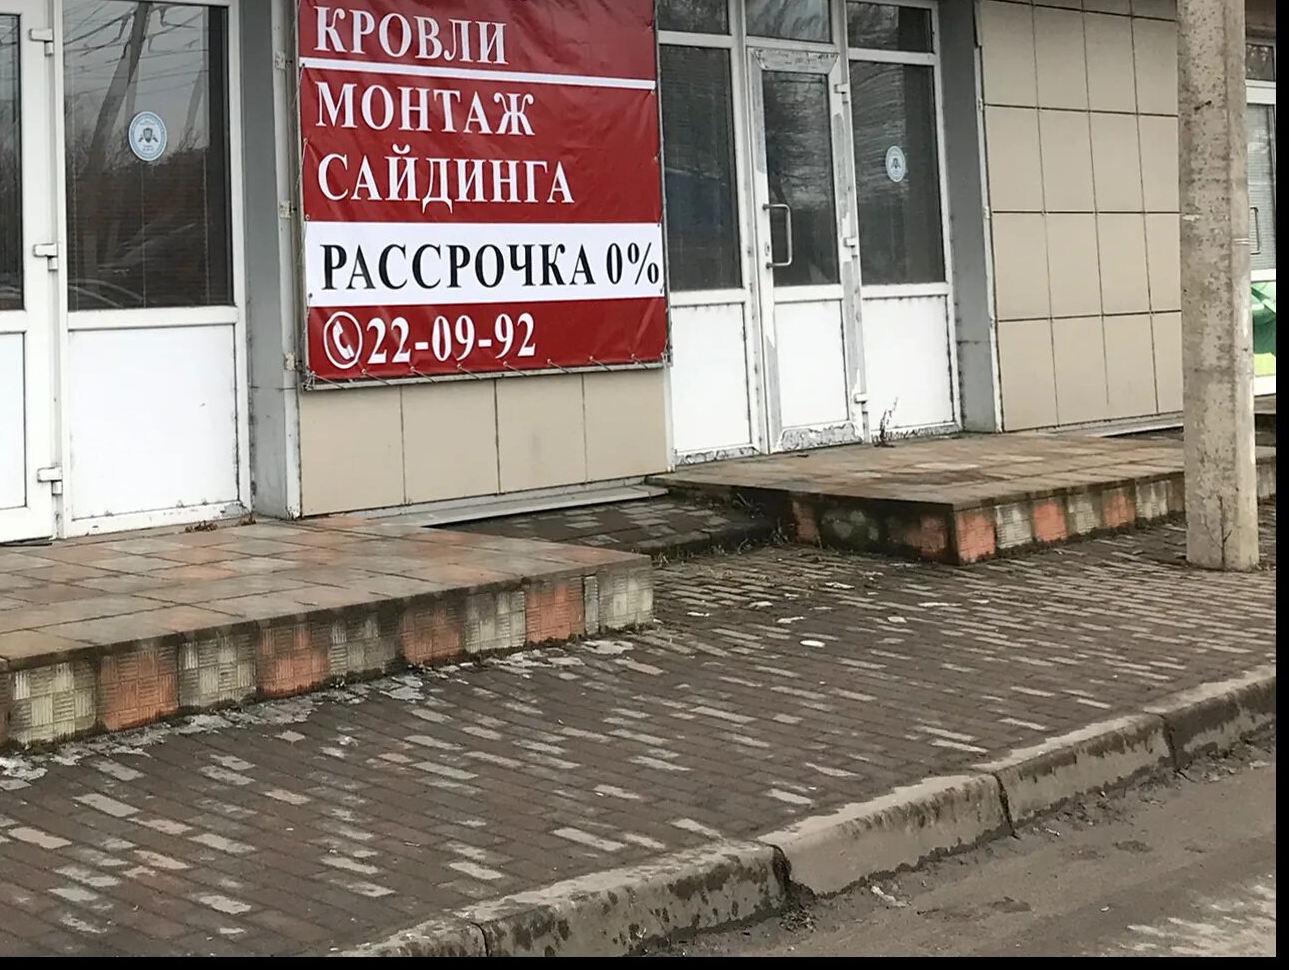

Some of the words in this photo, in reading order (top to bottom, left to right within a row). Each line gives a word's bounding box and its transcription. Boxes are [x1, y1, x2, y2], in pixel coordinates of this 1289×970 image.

[313, 5, 510, 66] КРОВЛИ
[315, 81, 535, 136] МОНТАЖ
[318, 144, 575, 214] САЙДИНГА
[320, 243, 596, 290] РАССРОЧКА
[606, 242, 659, 285] 0%
[366, 312, 536, 365] 22-09-92
